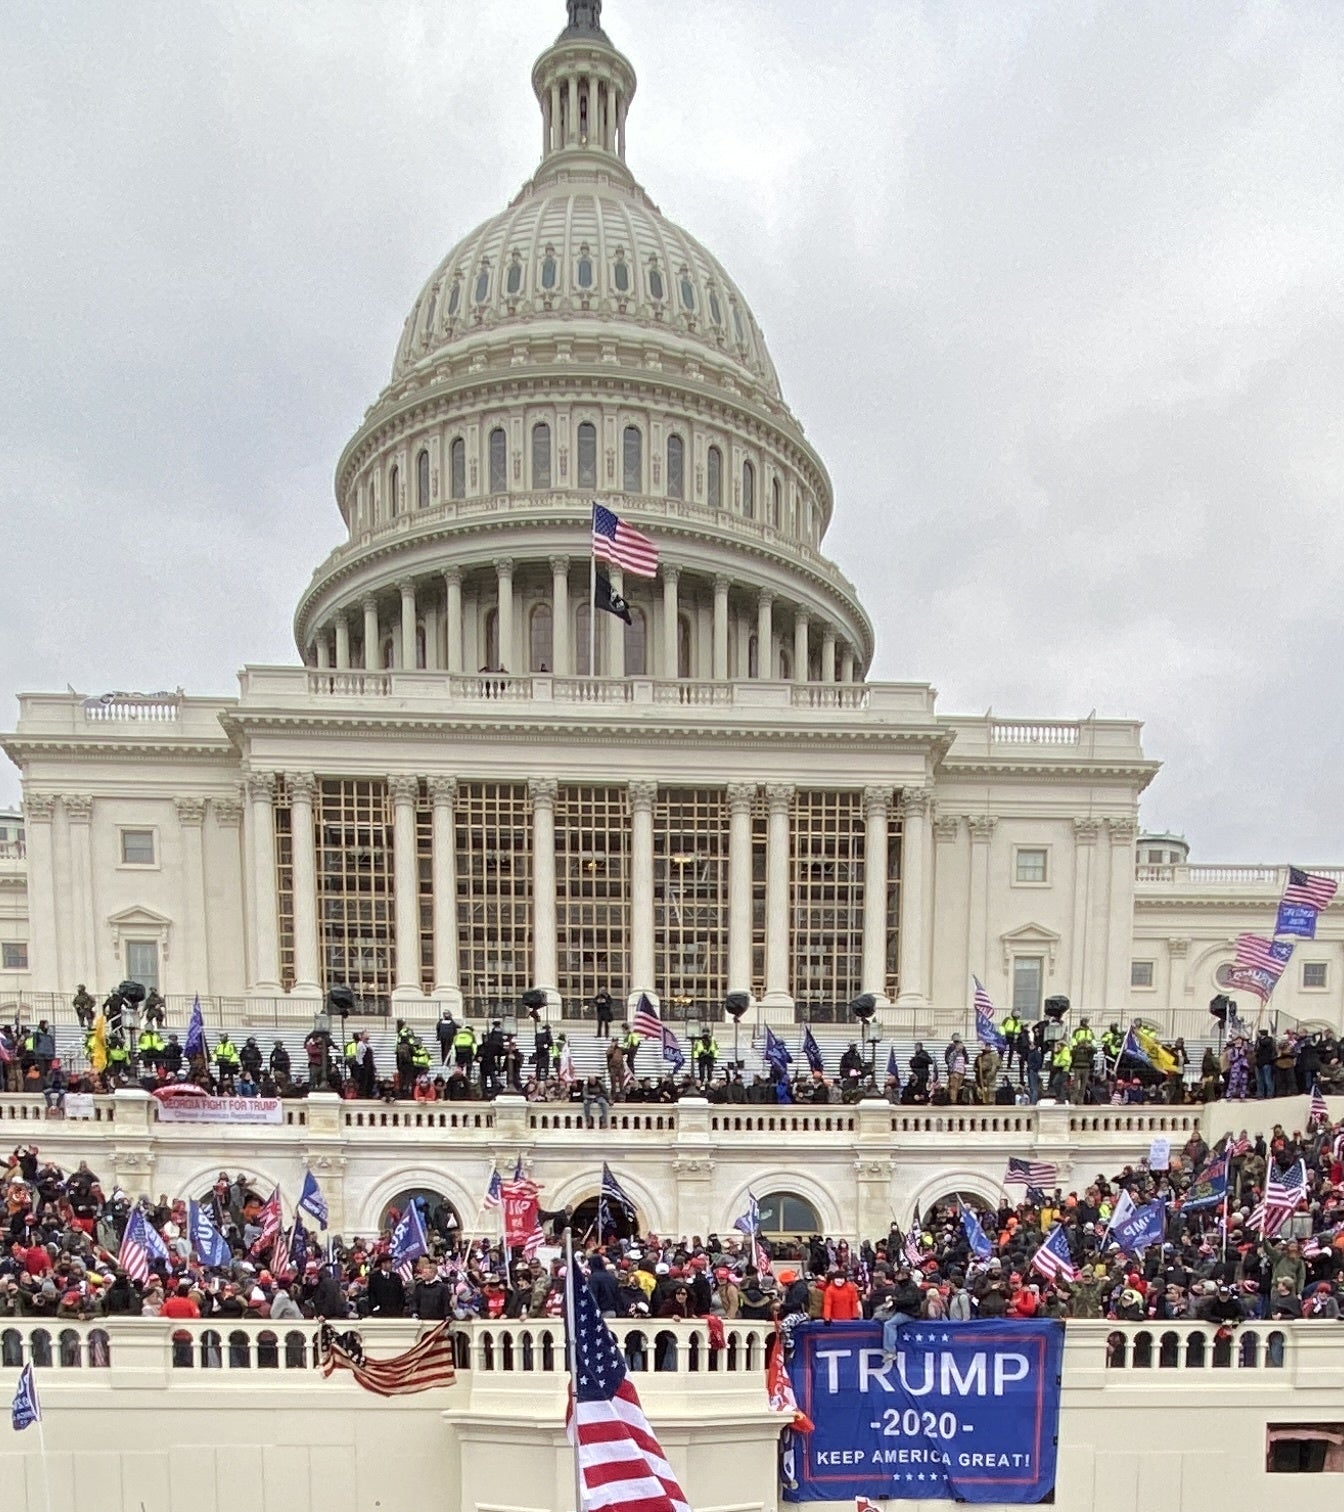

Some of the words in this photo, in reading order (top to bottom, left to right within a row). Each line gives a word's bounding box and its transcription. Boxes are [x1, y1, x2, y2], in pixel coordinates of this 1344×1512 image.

[250, 1101, 277, 1111] TRUMP
[815, 1348, 1030, 1396] TRUMP
[816, 1451, 865, 1465] KEEP
[871, 1449, 953, 1466] AMERICA
[958, 1452, 1031, 1468] GREAT!
